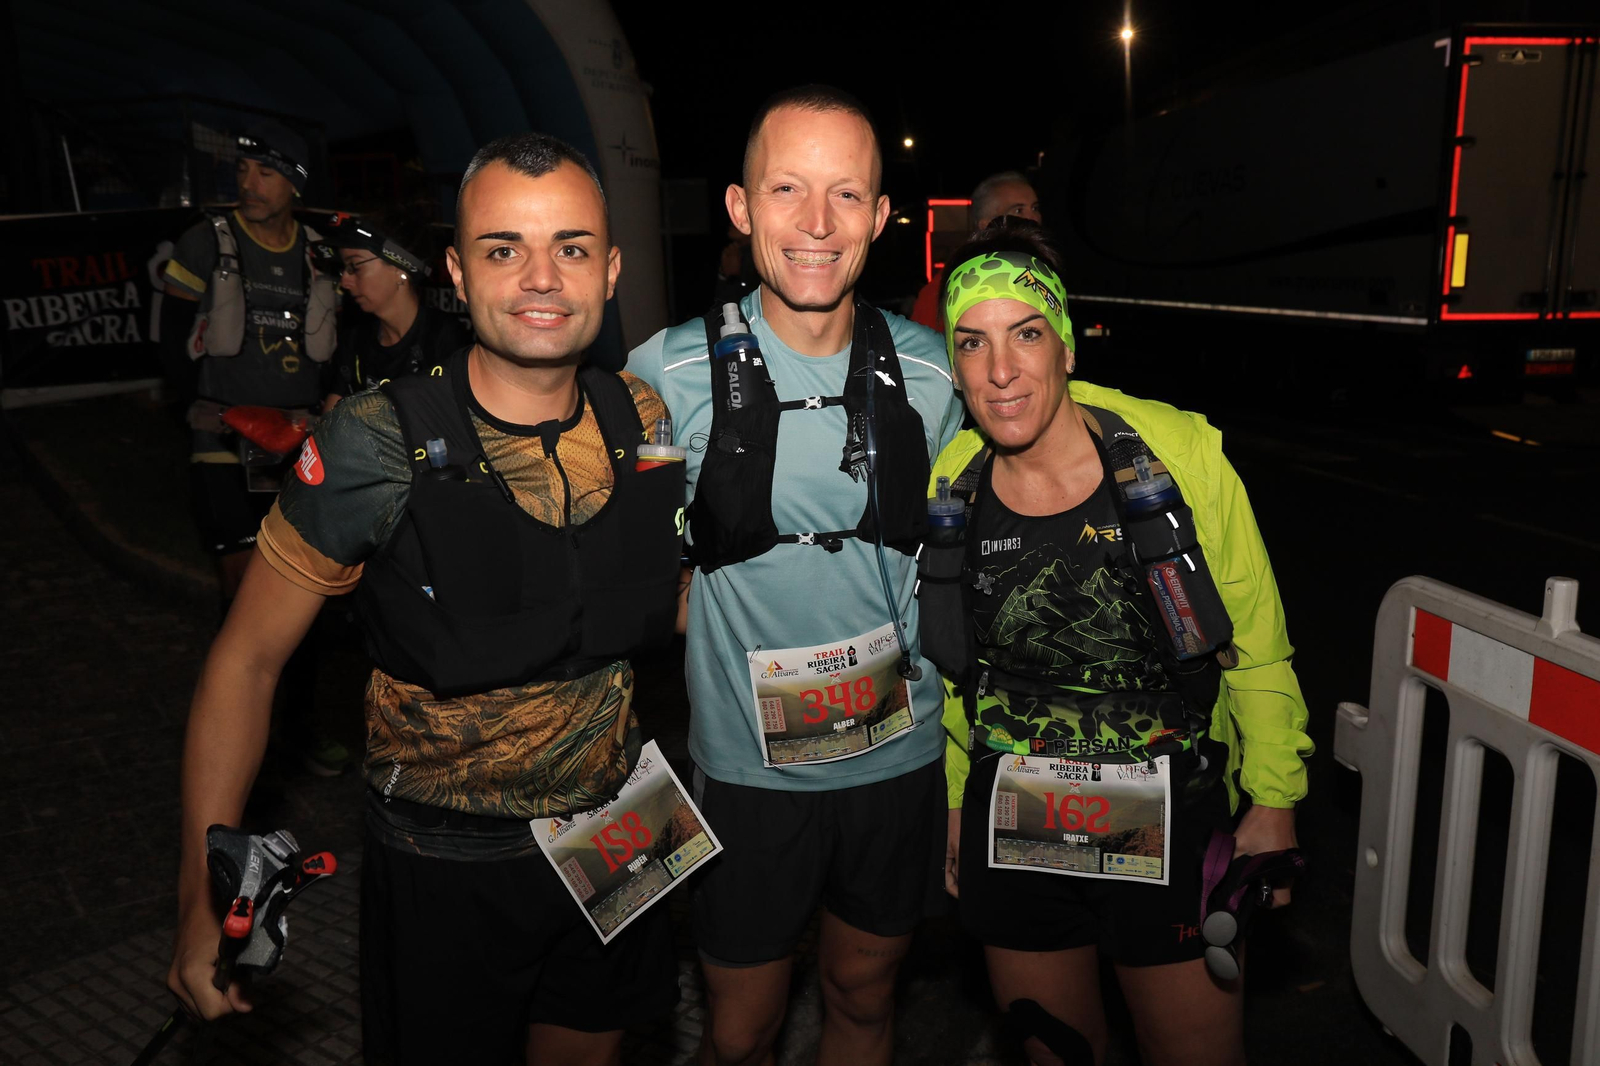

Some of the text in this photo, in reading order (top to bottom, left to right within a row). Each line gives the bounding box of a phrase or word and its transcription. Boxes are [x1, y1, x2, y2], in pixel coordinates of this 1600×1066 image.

[29, 251, 138, 291] TRAIL
[3, 281, 142, 330] RIBEIRA
[46, 312, 142, 348] SACRA
[1170, 577, 1191, 609] ENERVIT
[1163, 595, 1184, 632] PROTEÍNAS
[807, 656, 846, 669] RIBEIRA
[814, 648, 845, 660] TRAIL
[816, 663, 847, 675] SACRA
[800, 676, 877, 724] 348
[833, 718, 855, 731] ALBER
[1054, 736, 1131, 754] PERSAN
[1049, 763, 1089, 773] RIBEIRA
[1057, 772, 1089, 782] SACRA
[1043, 792, 1111, 833] 162
[590, 811, 653, 875] 158
[1063, 833, 1089, 843] IRATXE
[250, 848, 260, 874] LEKI
[627, 853, 648, 873] RUBÉN
